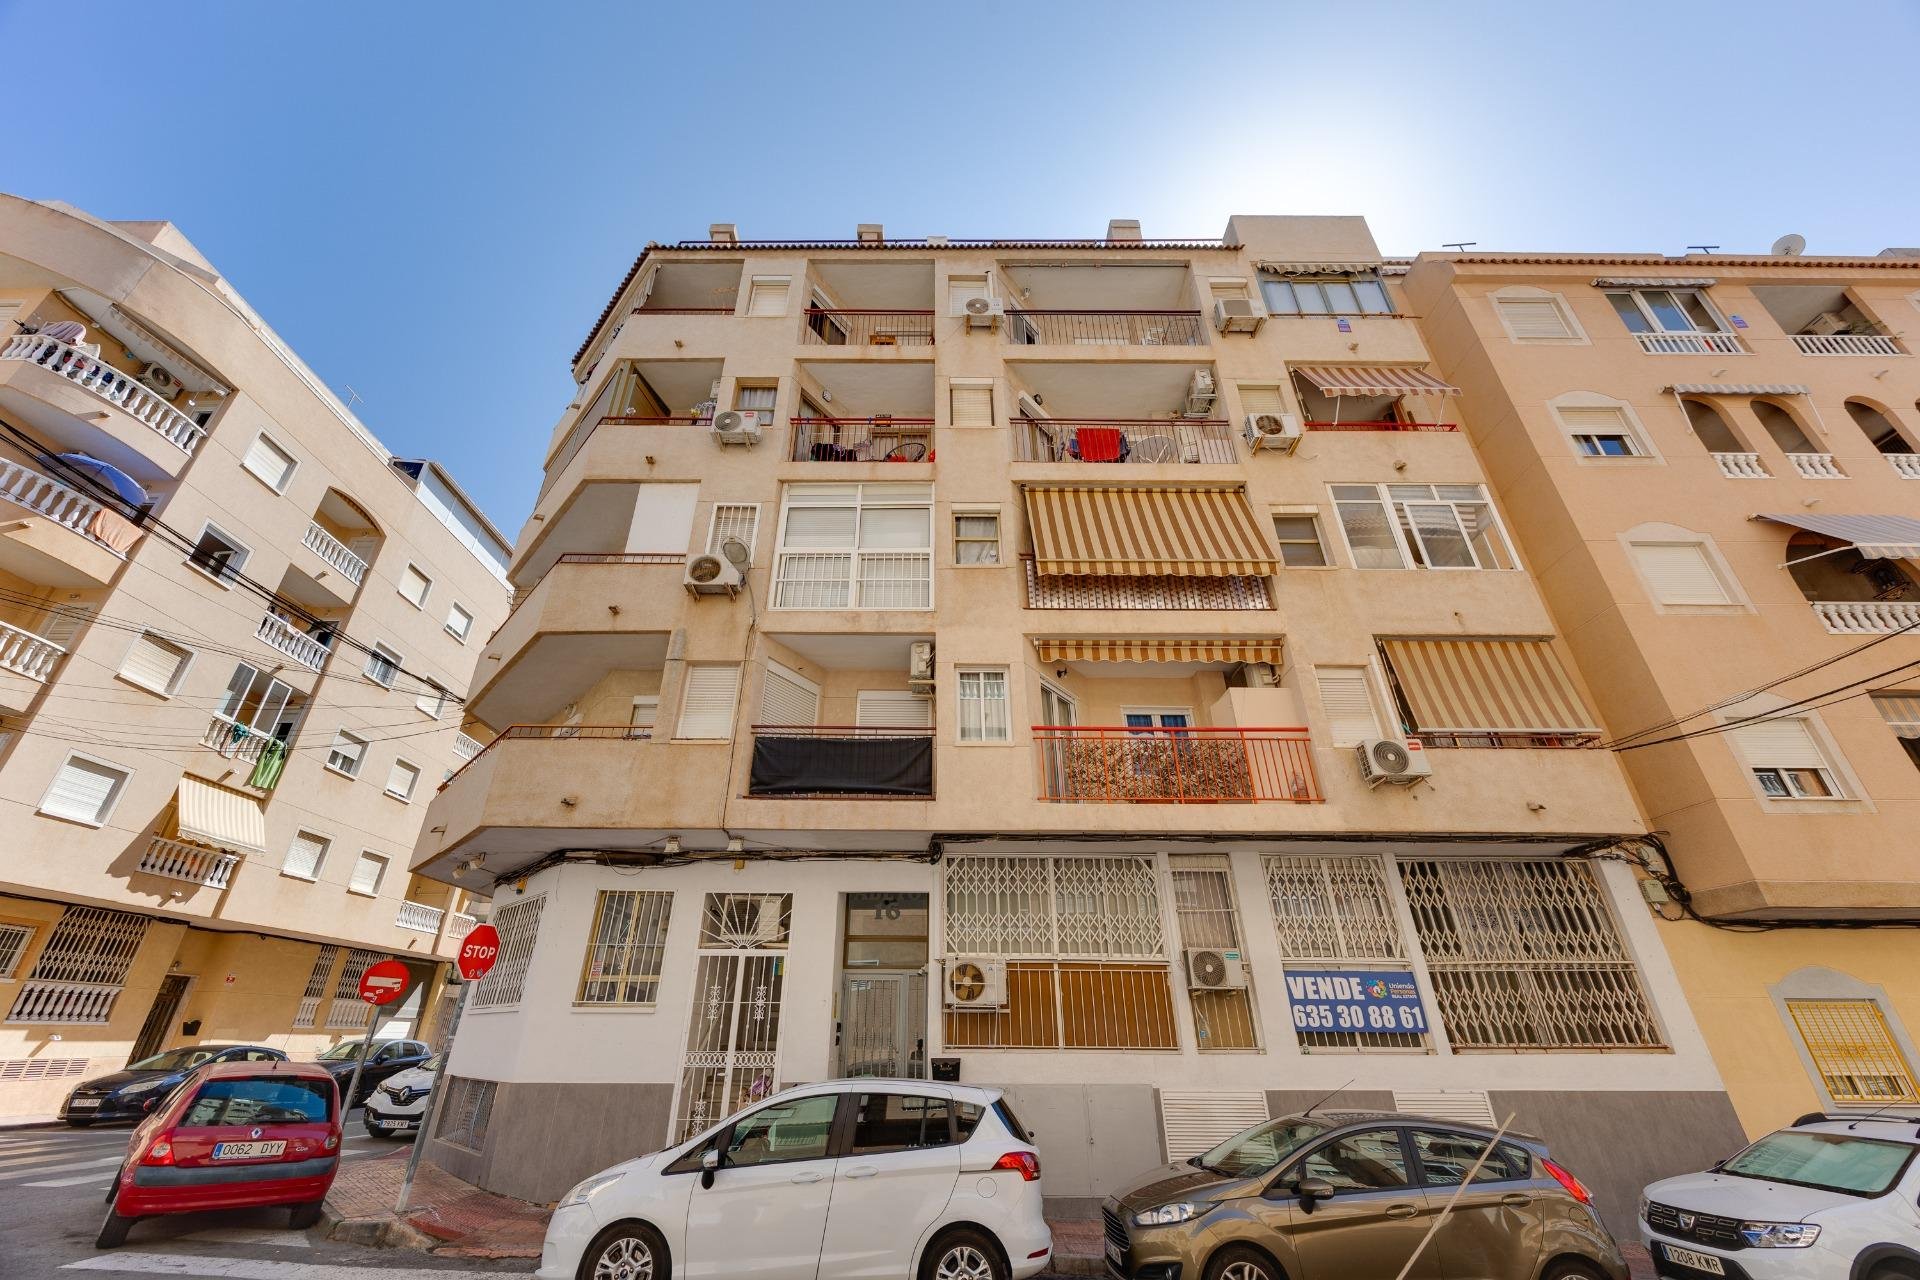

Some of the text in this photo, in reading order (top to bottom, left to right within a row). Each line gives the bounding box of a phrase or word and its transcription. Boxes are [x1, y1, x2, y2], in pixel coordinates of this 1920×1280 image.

[873, 904, 901, 920] 16
[463, 944, 496, 959] STOP
[1286, 976, 1365, 1000] VENDE
[1388, 982, 1415, 990] Uniendo
[1292, 1004, 1424, 1029] 635 30 88 61
[222, 1144, 253, 1156] 0062
[260, 1142, 284, 1154] DYY
[1668, 1247, 1695, 1266] 1208
